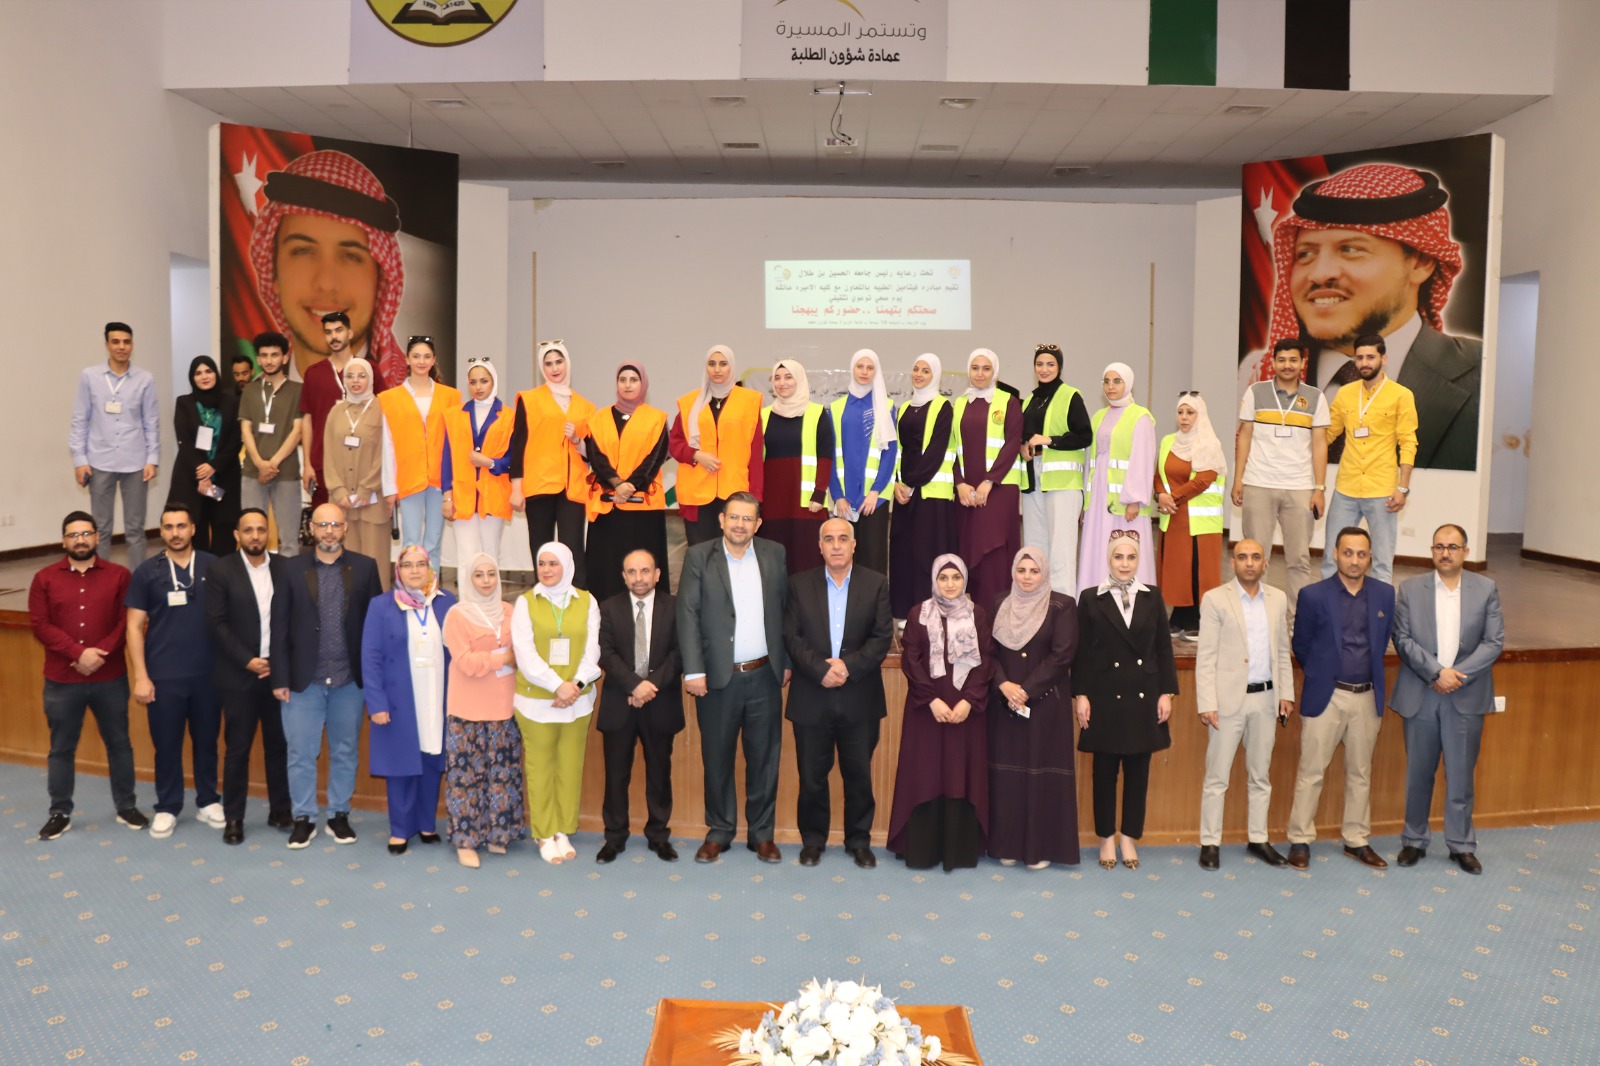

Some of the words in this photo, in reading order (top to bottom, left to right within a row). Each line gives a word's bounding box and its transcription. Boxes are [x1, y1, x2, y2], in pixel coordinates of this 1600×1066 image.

[776, 20, 851, 39] المسيرة
[855, 23, 927, 41] وتستمر
[791, 47, 827, 65] الطلبة
[829, 47, 866, 65] شؤون
[868, 48, 901, 63] عمادة
[798, 268, 814, 278] طلال
[817, 269, 826, 278] بن
[828, 268, 851, 278] الحسين
[919, 268, 934, 276] تحت
[876, 304, 902, 317] بتهمنا
[907, 304, 937, 316] صحتكم
